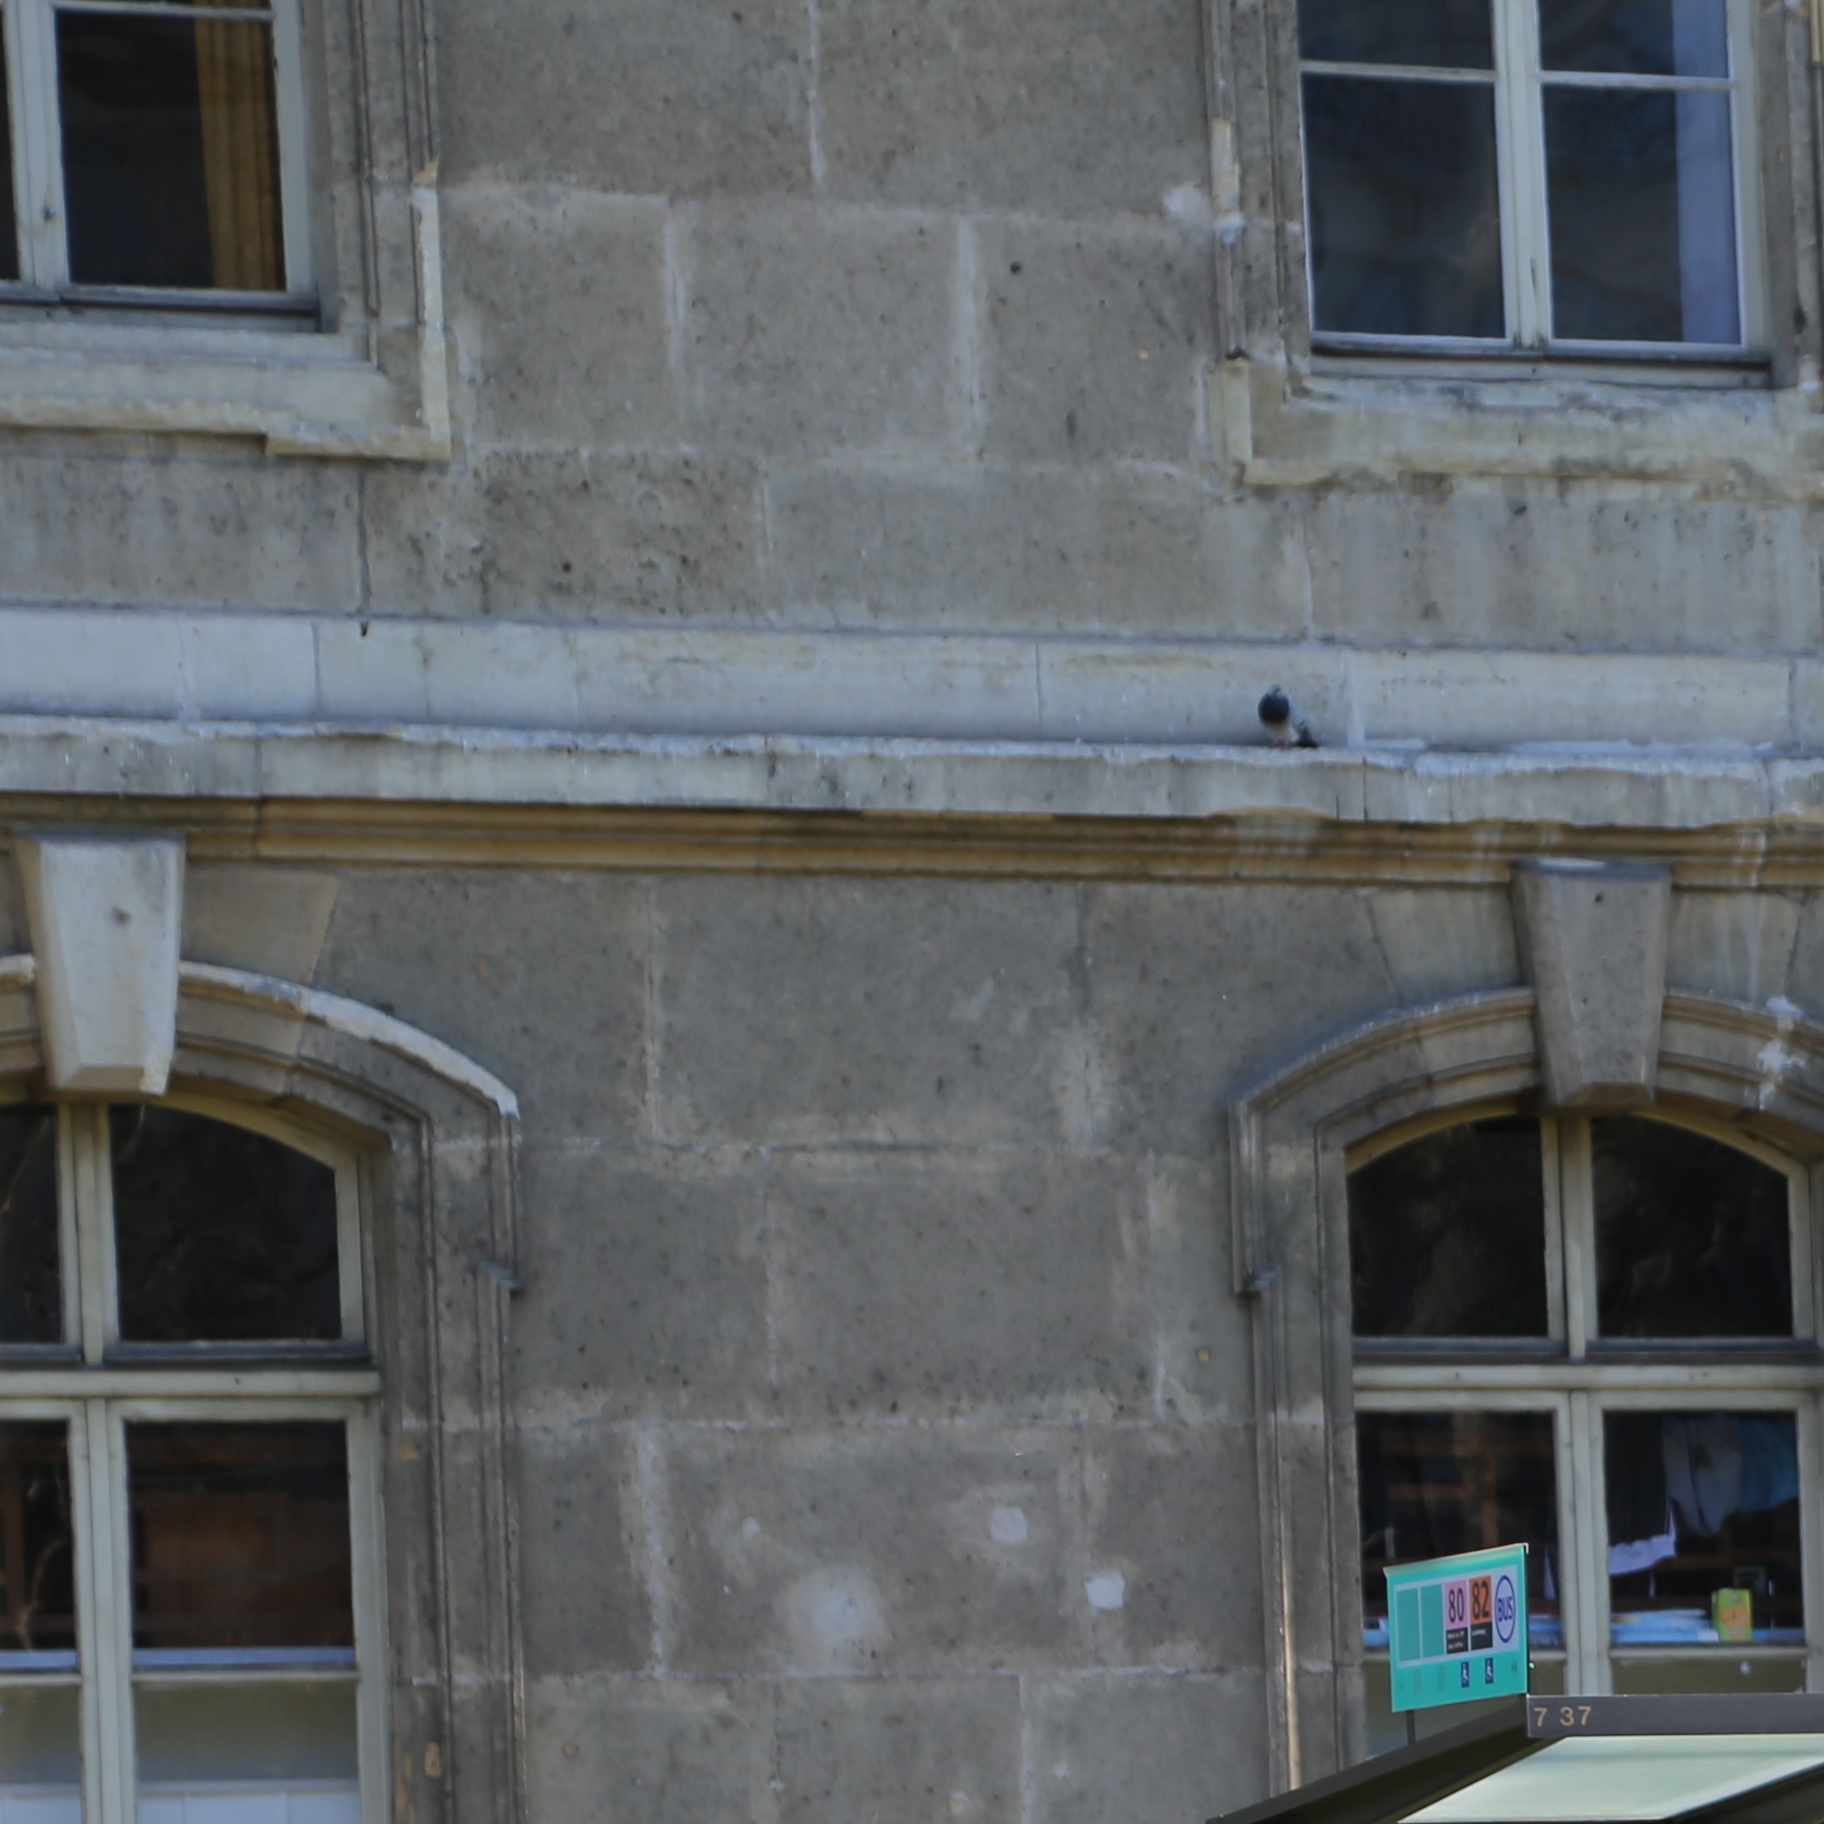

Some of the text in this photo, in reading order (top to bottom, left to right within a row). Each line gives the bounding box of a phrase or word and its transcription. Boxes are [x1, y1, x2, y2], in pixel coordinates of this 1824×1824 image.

[1447, 1587, 1465, 1623] 80
[1471, 1581, 1490, 1620] 82
[1497, 1596, 1514, 1622] BUS
[1533, 1705, 1592, 1726] 7 37
